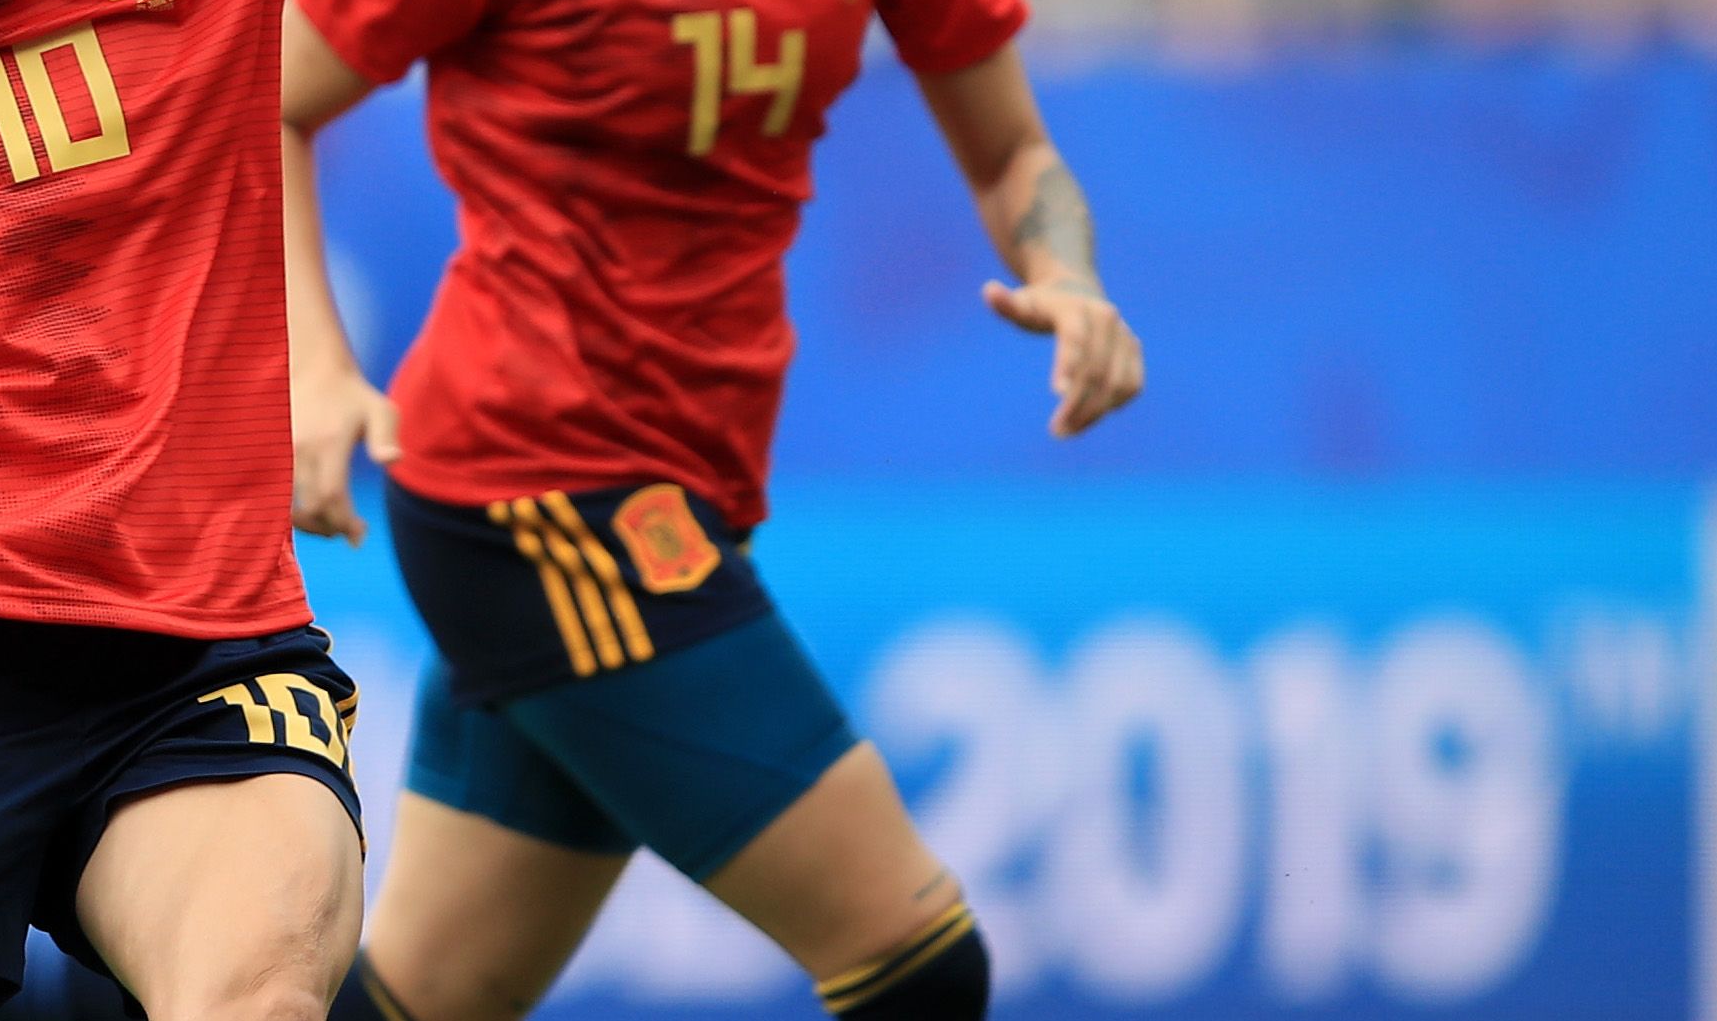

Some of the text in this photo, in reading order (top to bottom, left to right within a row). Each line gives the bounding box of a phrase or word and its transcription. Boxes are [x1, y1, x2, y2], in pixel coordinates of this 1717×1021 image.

[671, 6, 808, 157] 14
[196, 672, 346, 769] 10
[864, 612, 1562, 1005] 2019
